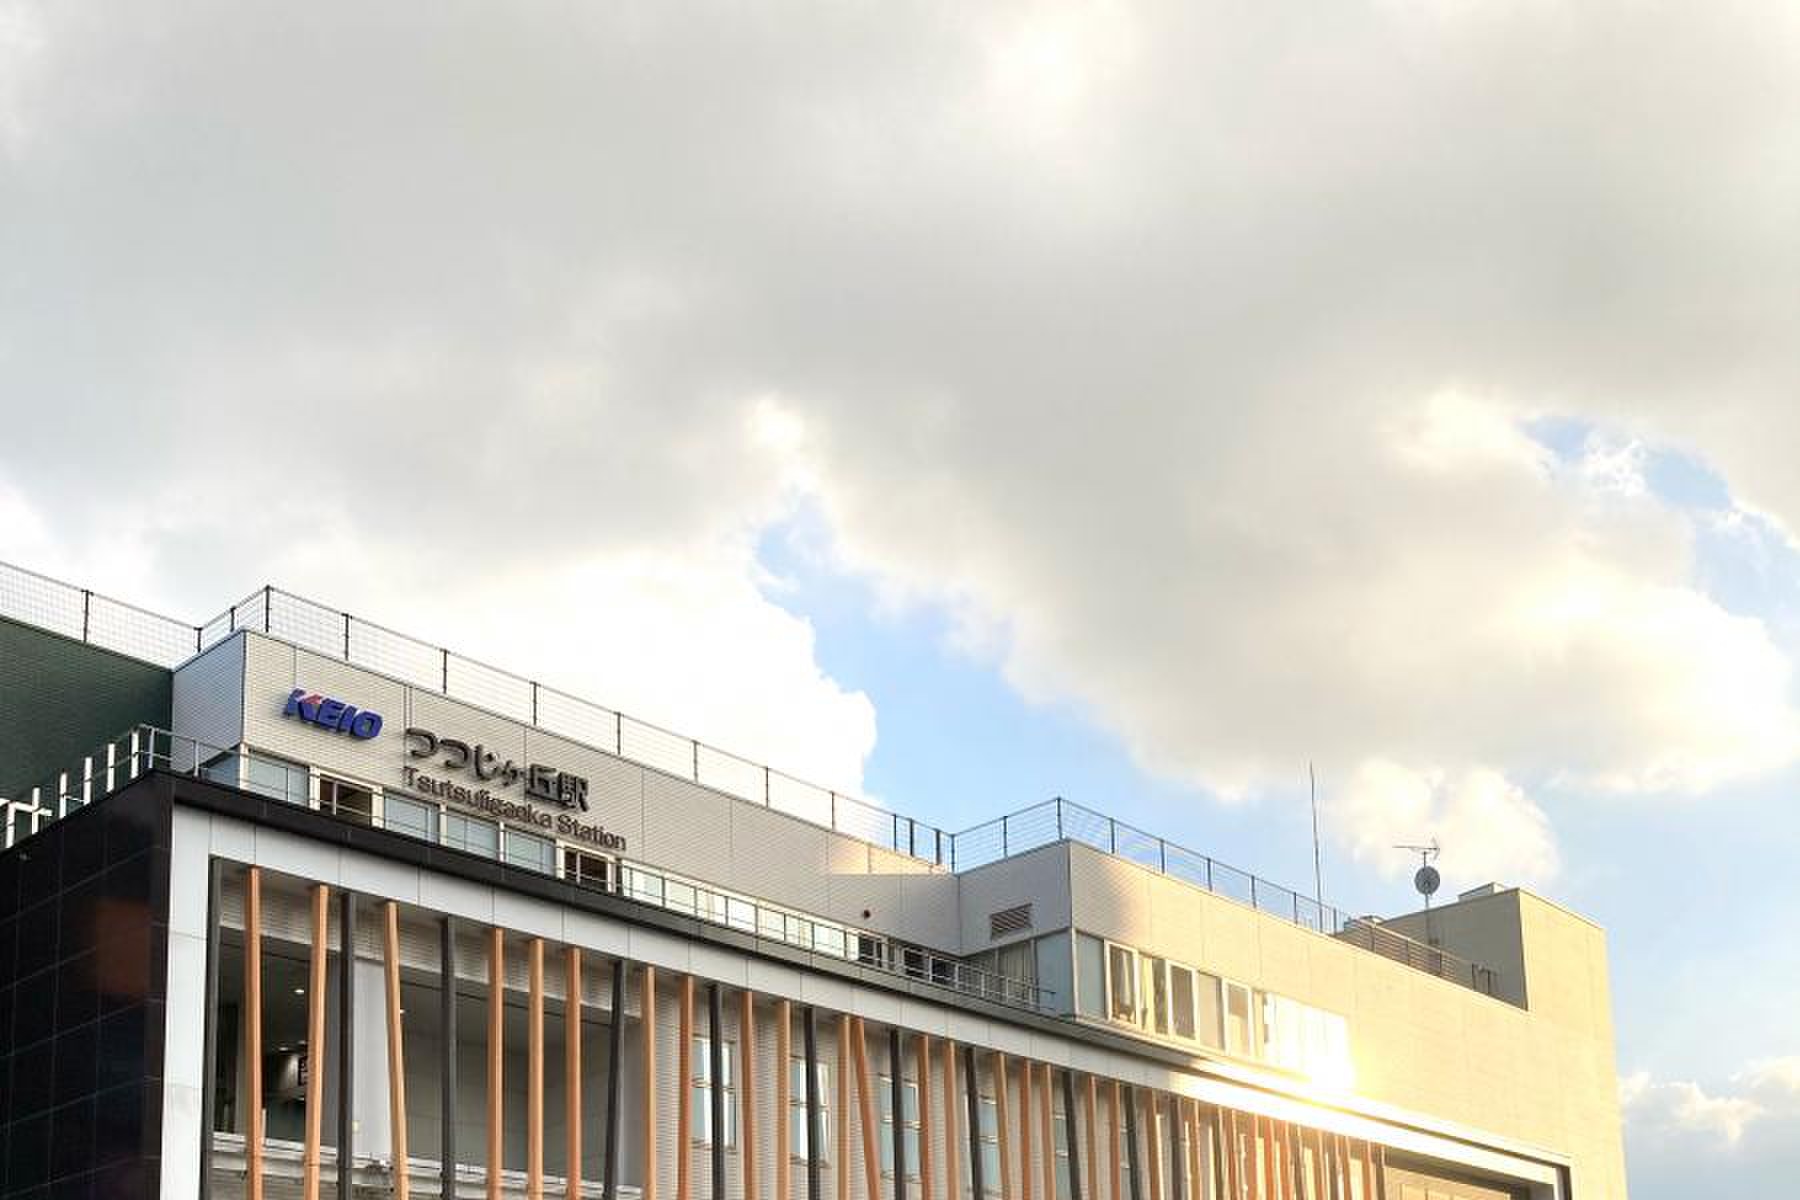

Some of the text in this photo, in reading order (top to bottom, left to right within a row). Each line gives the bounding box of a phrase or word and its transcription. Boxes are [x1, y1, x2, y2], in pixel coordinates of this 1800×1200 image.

[283, 687, 384, 741] KEIO
[402, 765, 627, 852] Tsutsujigaoka Station
